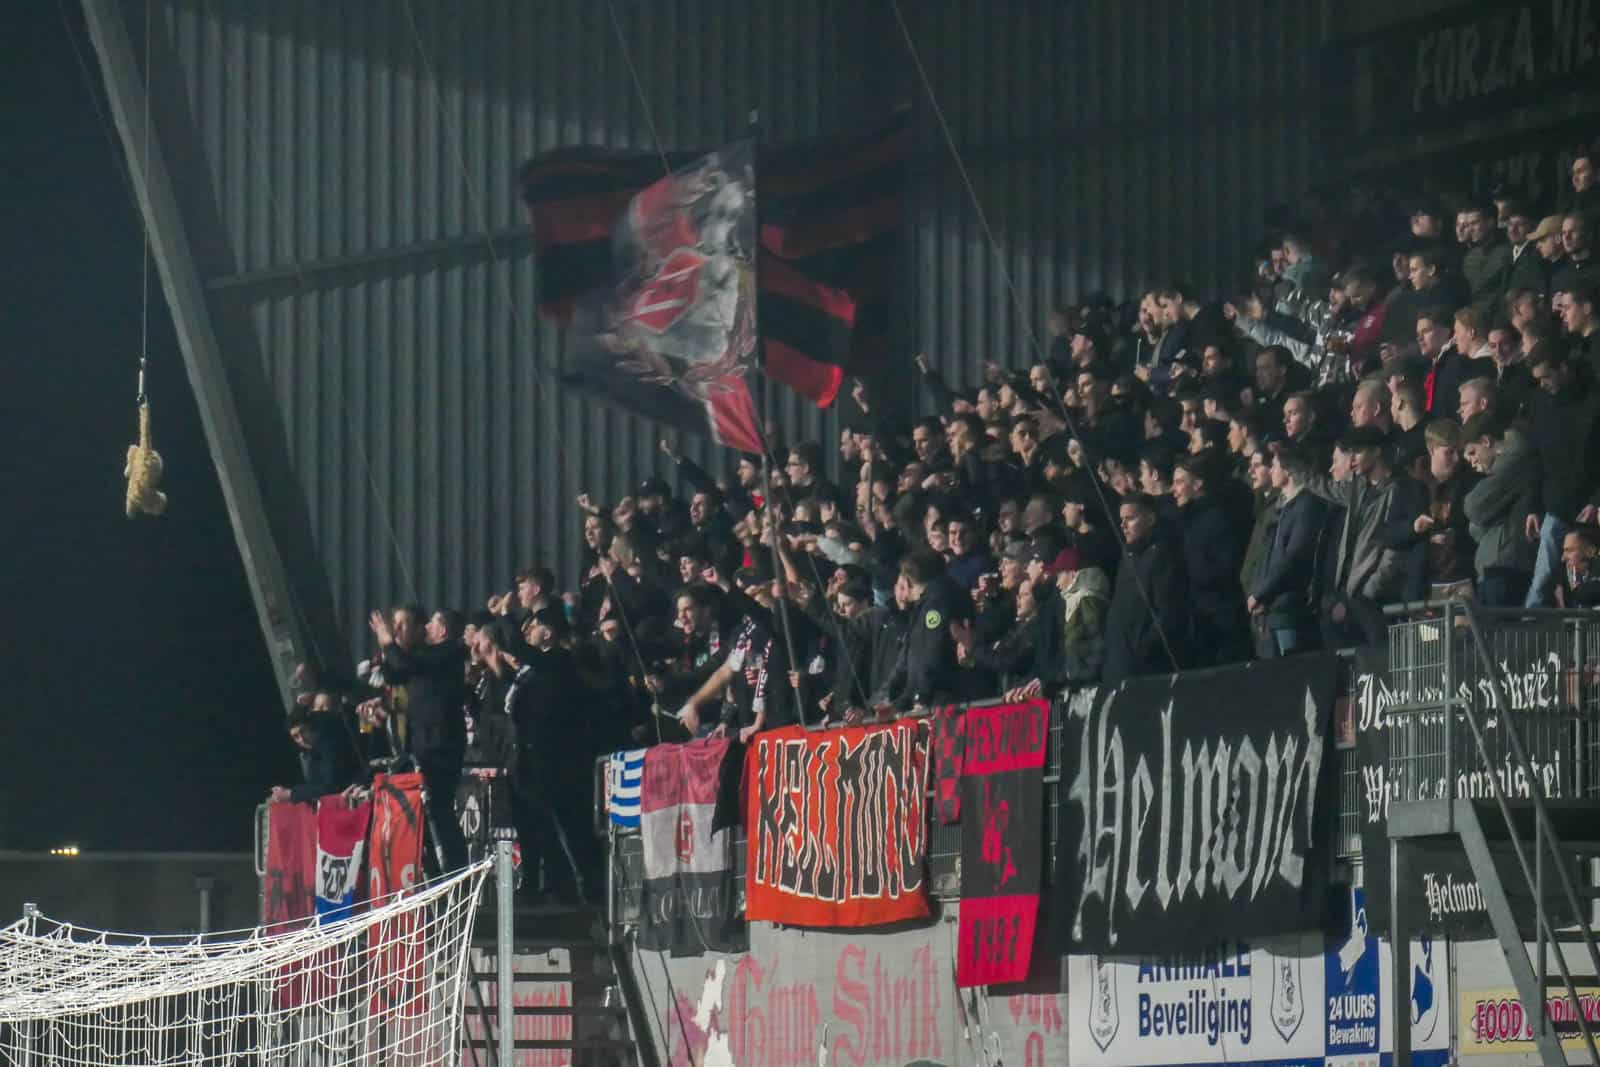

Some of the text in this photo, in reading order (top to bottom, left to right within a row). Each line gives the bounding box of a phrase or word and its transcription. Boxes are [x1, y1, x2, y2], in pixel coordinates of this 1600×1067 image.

[1138, 988, 1252, 1046] Beveiliging
[1328, 993, 1376, 1021] 24 UURS
[1475, 999, 1523, 1042] FOOD
[1328, 1022, 1376, 1047] Bewaking
